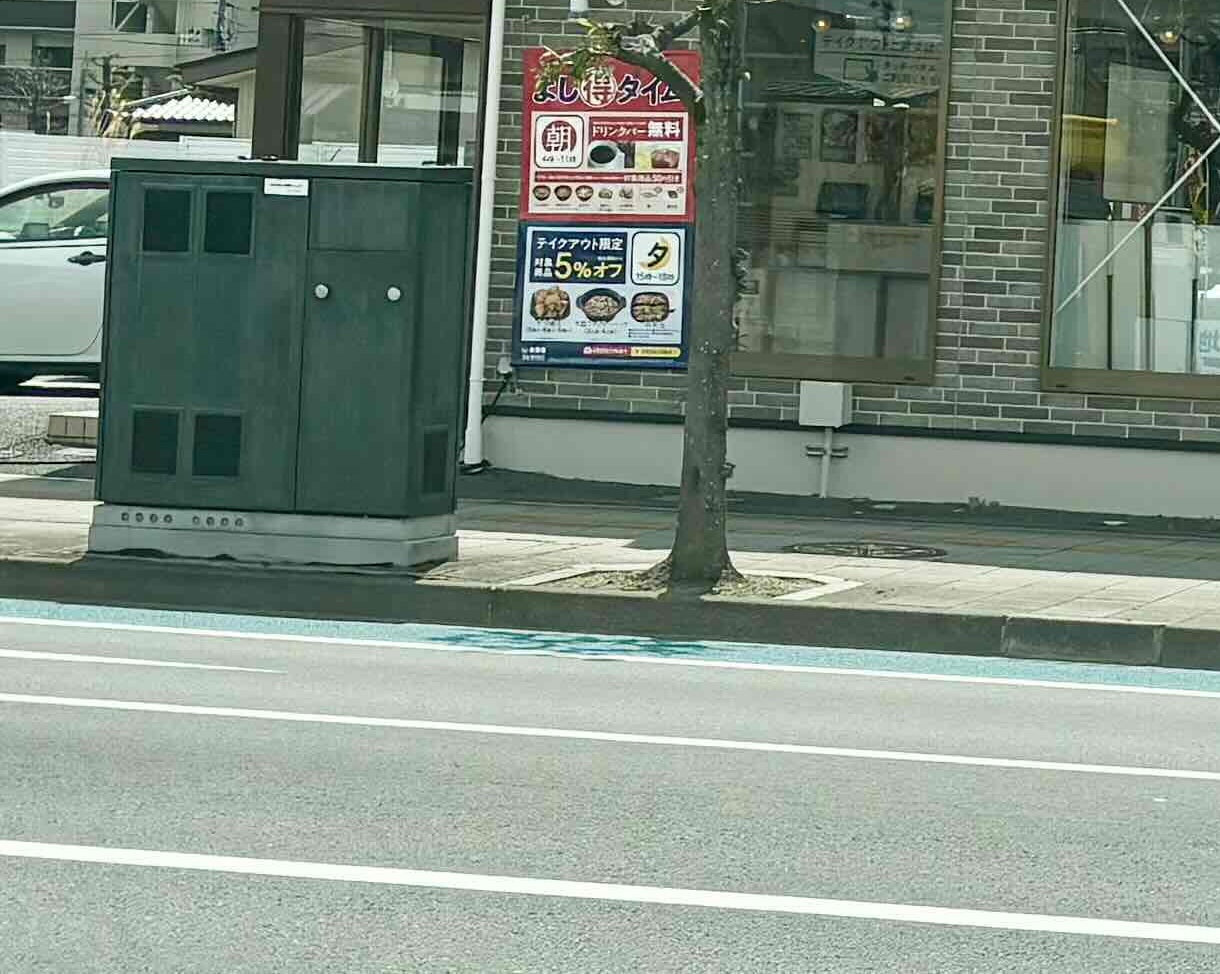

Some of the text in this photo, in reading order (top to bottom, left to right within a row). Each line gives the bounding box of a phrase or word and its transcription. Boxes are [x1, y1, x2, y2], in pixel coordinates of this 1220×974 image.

[545, 124, 572, 153] 朝
[536, 236, 624, 251] テイクアウト限定
[554, 251, 623, 280] 5%オフ
